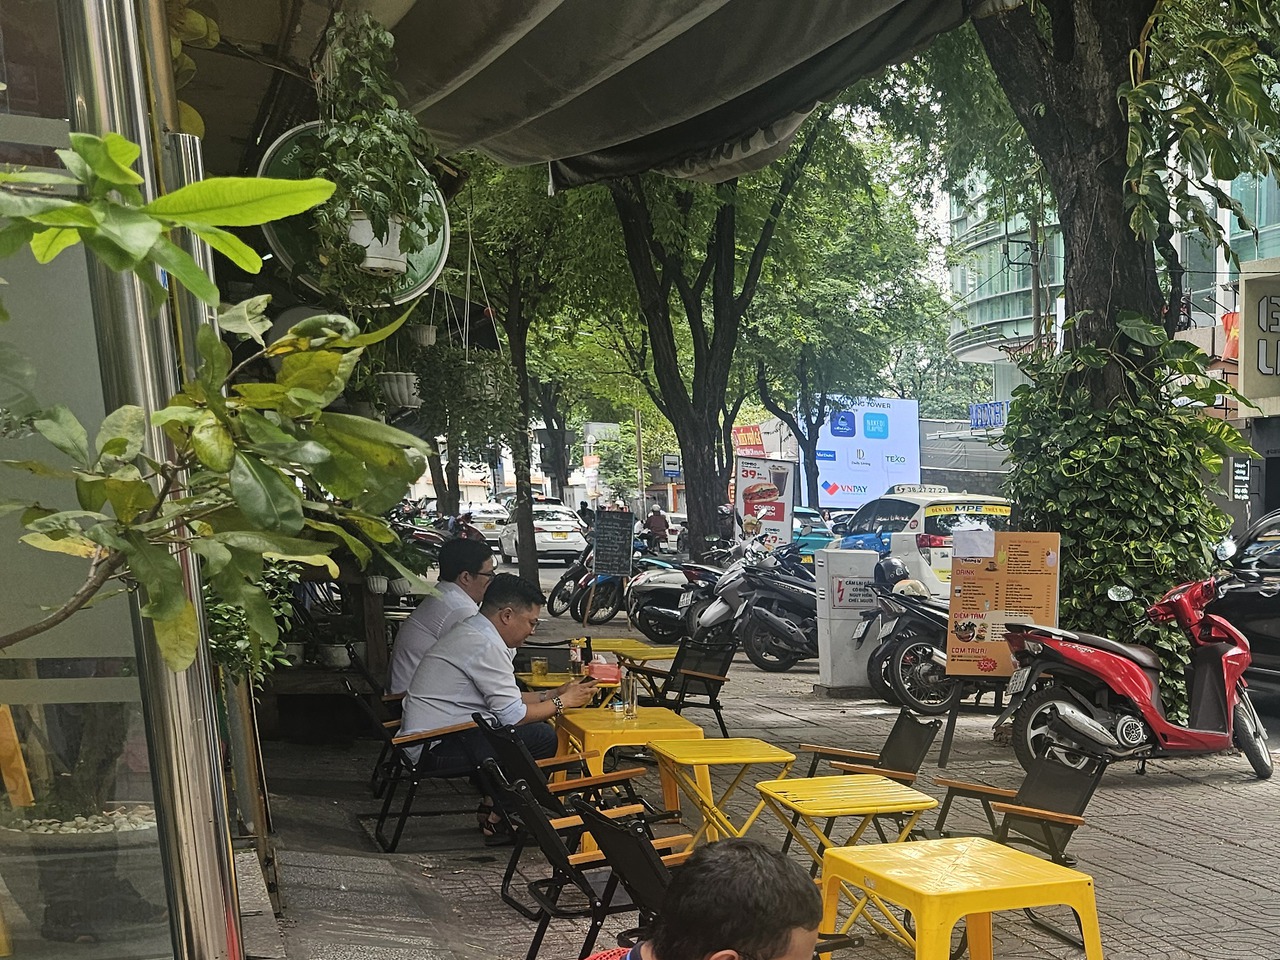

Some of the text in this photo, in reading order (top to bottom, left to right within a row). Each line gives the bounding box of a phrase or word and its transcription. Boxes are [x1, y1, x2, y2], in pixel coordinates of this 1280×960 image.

[866, 401, 891, 409] TOWER
[885, 455, 906, 463] TEXO
[741, 469, 757, 479] 39
[840, 484, 868, 493] VNPAY
[954, 505, 983, 513] MPE
